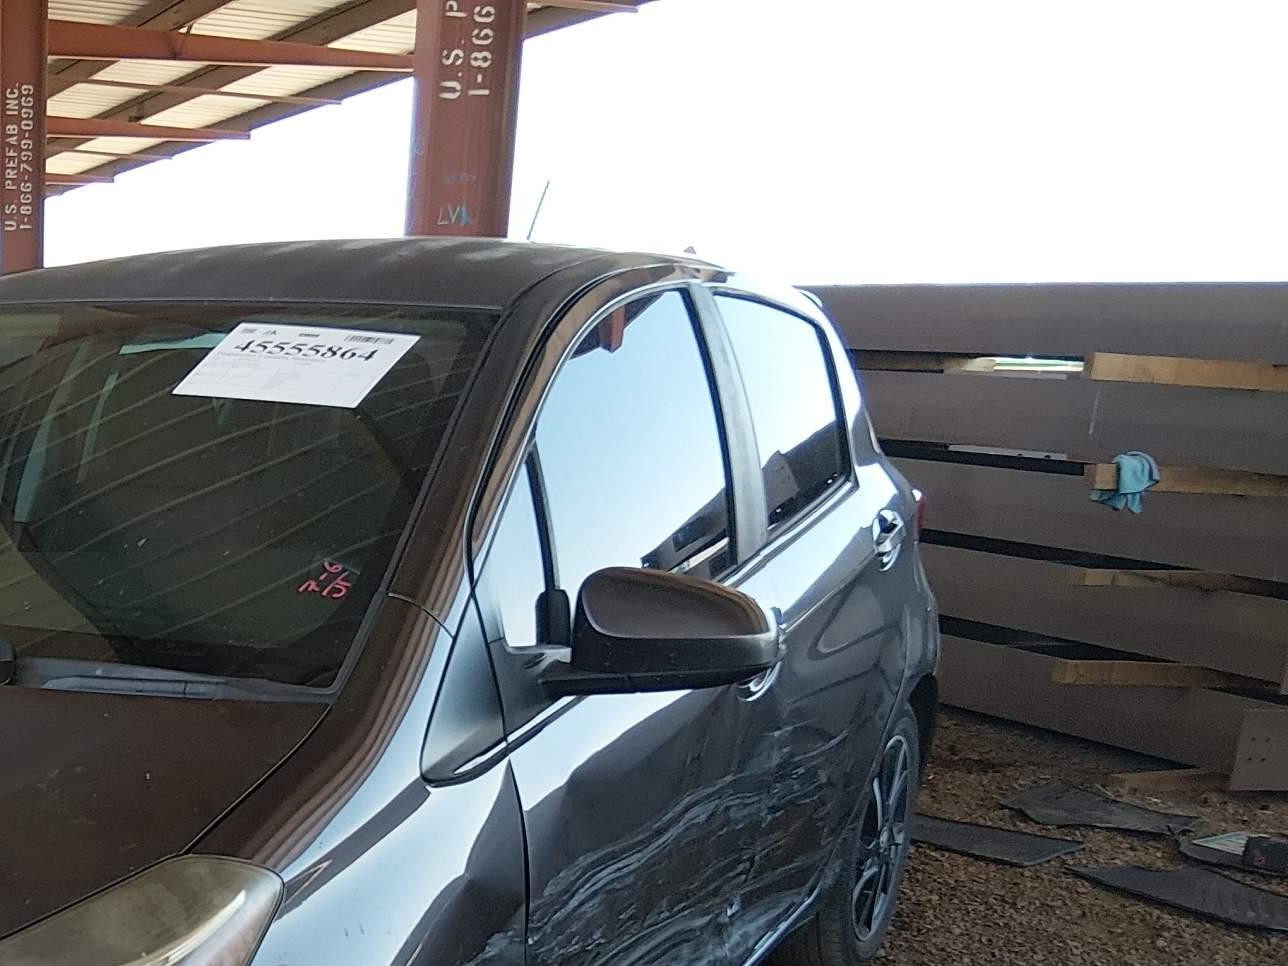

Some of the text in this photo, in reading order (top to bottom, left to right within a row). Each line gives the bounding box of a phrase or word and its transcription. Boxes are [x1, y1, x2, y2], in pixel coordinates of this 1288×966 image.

[5, 82, 20, 115] INC.
[5, 123, 19, 190] PREFAB
[19, 84, 35, 230] 1-866-799-0969
[235, 339, 380, 362] 45555864
